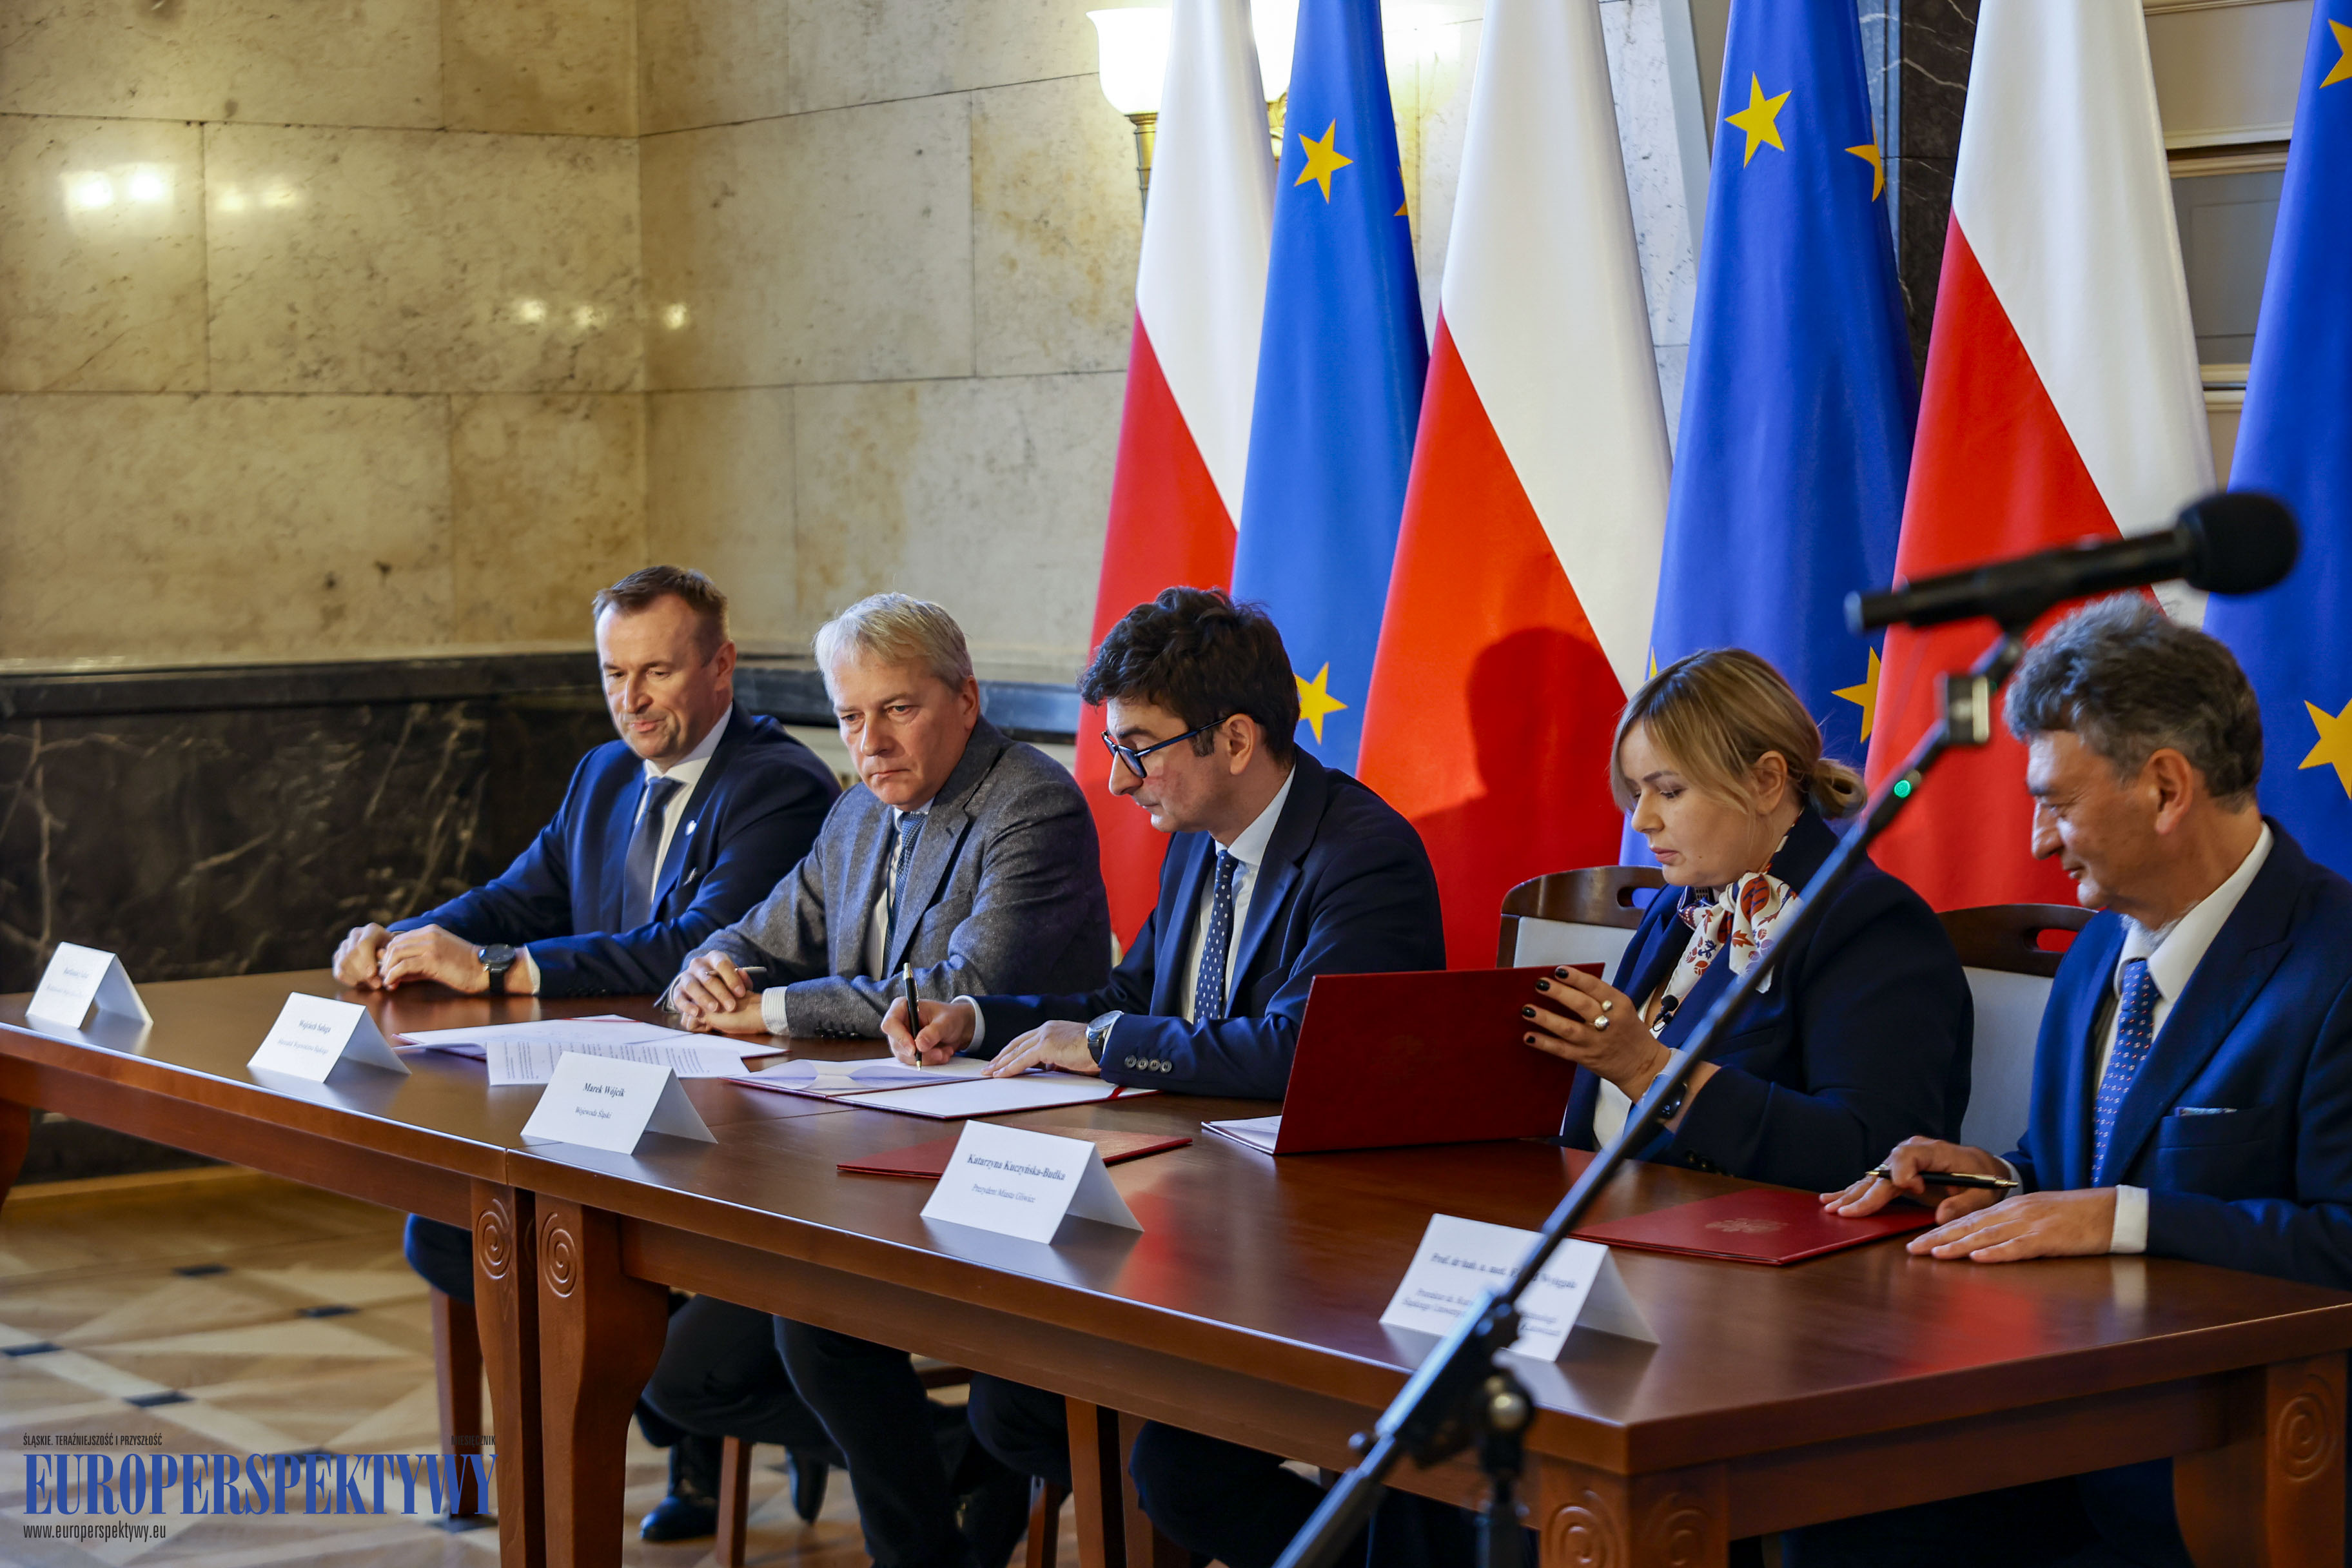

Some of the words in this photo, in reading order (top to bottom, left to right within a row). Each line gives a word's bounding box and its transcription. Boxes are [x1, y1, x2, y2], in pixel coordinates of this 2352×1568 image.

[583, 1083, 603, 1093] Marek
[604, 1086, 625, 1097] Wójcik
[967, 1154, 1002, 1170] Katarzyna
[1004, 1161, 1066, 1181] Kuczyńska-Budka
